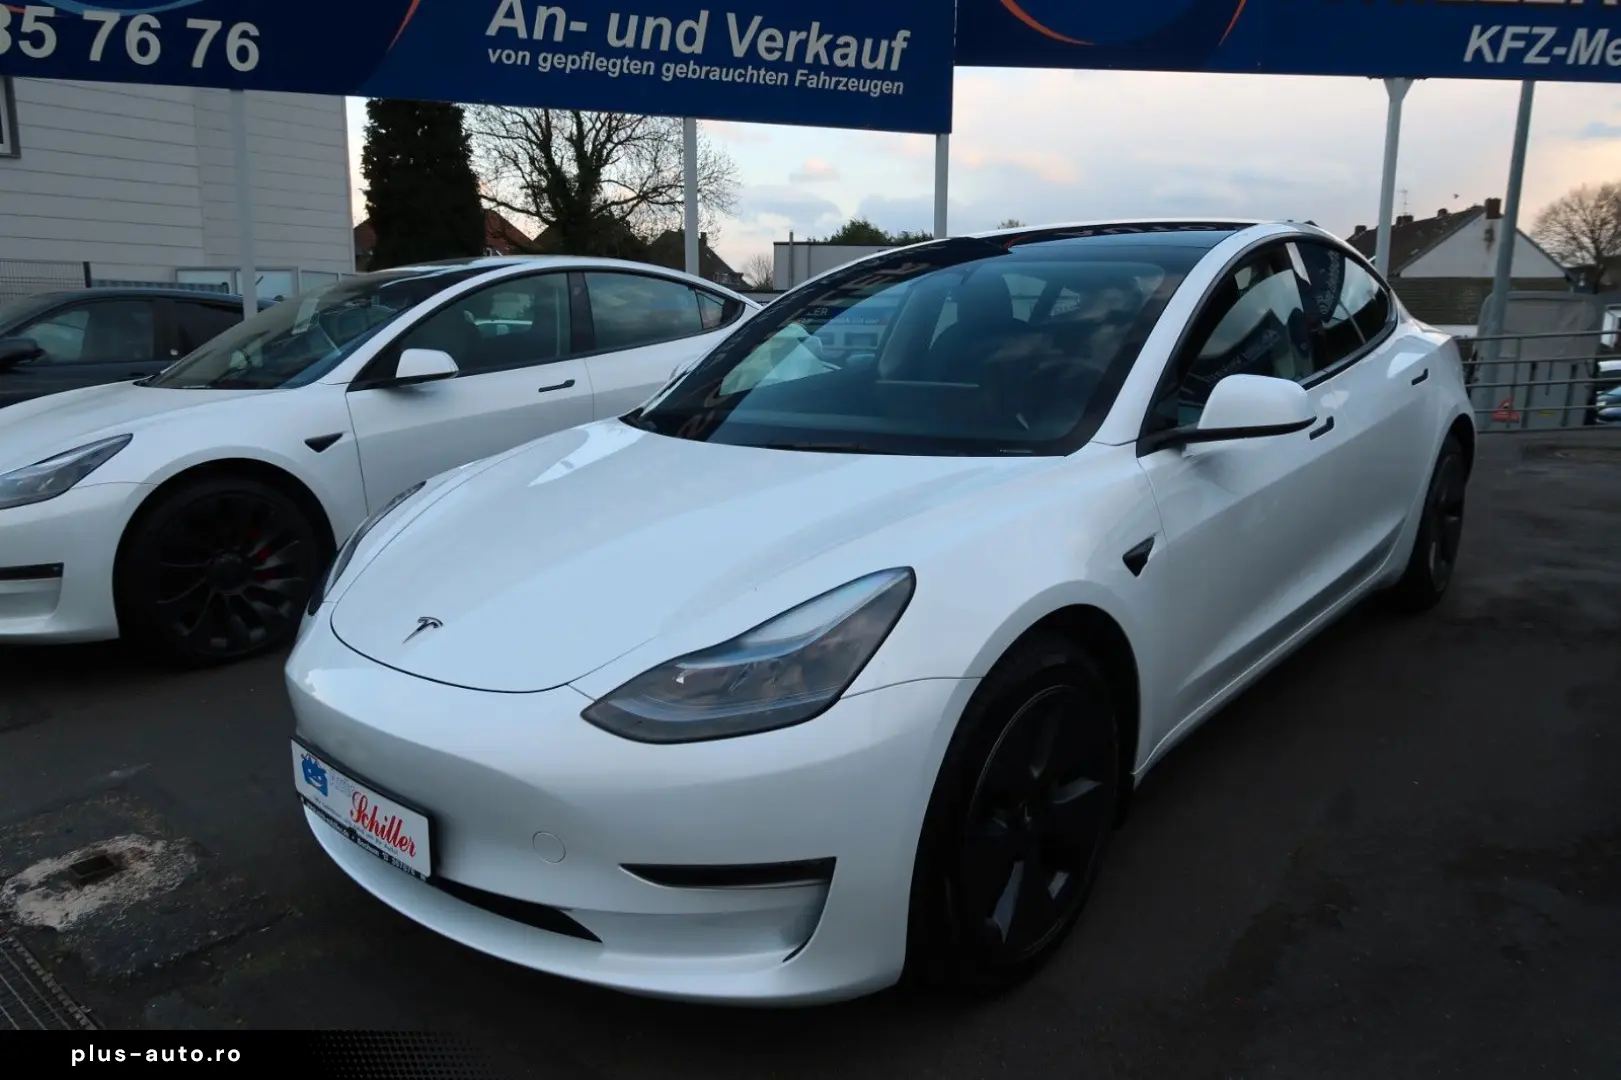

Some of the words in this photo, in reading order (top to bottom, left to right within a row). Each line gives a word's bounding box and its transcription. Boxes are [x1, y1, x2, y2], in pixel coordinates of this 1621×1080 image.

[83, 10, 161, 66] 76
[186, 18, 260, 72] 76
[485, 0, 588, 42] An-
[607, 9, 709, 54] und
[726, 12, 911, 72] Verkauf
[488, 48, 531, 66] von
[537, 51, 655, 78] gepflegten
[661, 60, 789, 88] gebrauchten
[794, 69, 904, 97] Fahrzeugen
[349, 791, 416, 858] Schiller
